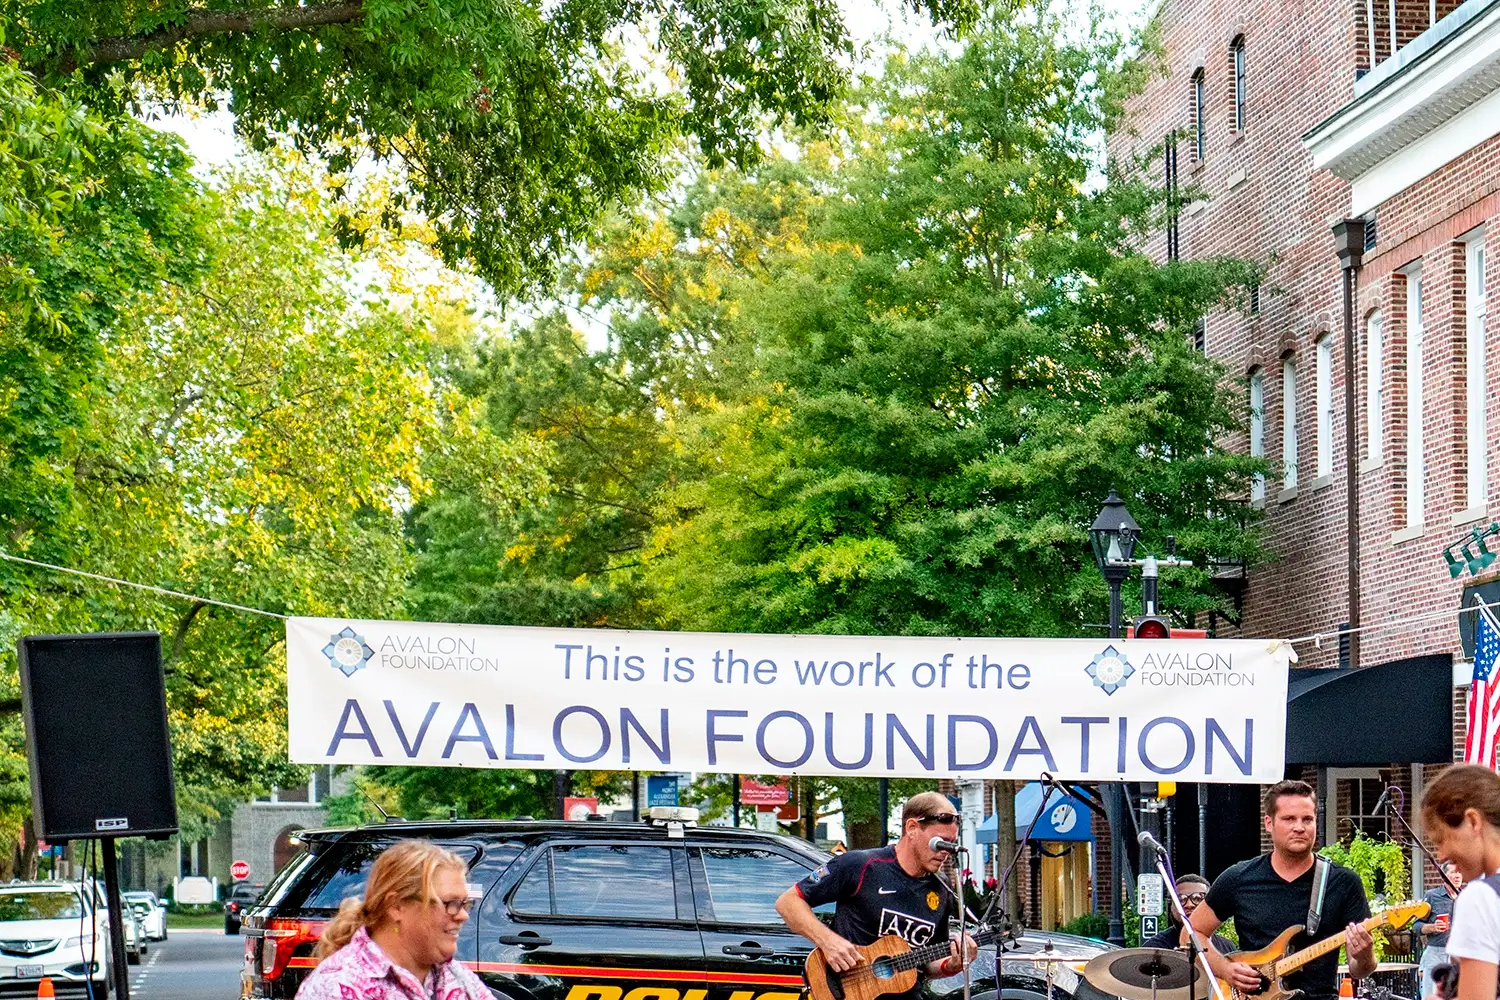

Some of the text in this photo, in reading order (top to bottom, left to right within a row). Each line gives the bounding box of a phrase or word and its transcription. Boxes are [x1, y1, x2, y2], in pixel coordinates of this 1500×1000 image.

[379, 634, 476, 655] AVALON
[380, 653, 499, 672] FOUNDATION
[554, 643, 1031, 690] This is the work of the
[1141, 652, 1233, 671] AVALON
[1141, 670, 1255, 687] FOUNDATION
[325, 698, 1254, 776] AVALON FOUNDATION
[97, 819, 127, 828] ISP
[232, 865, 249, 875] STOP
[882, 914, 931, 949] AIG
